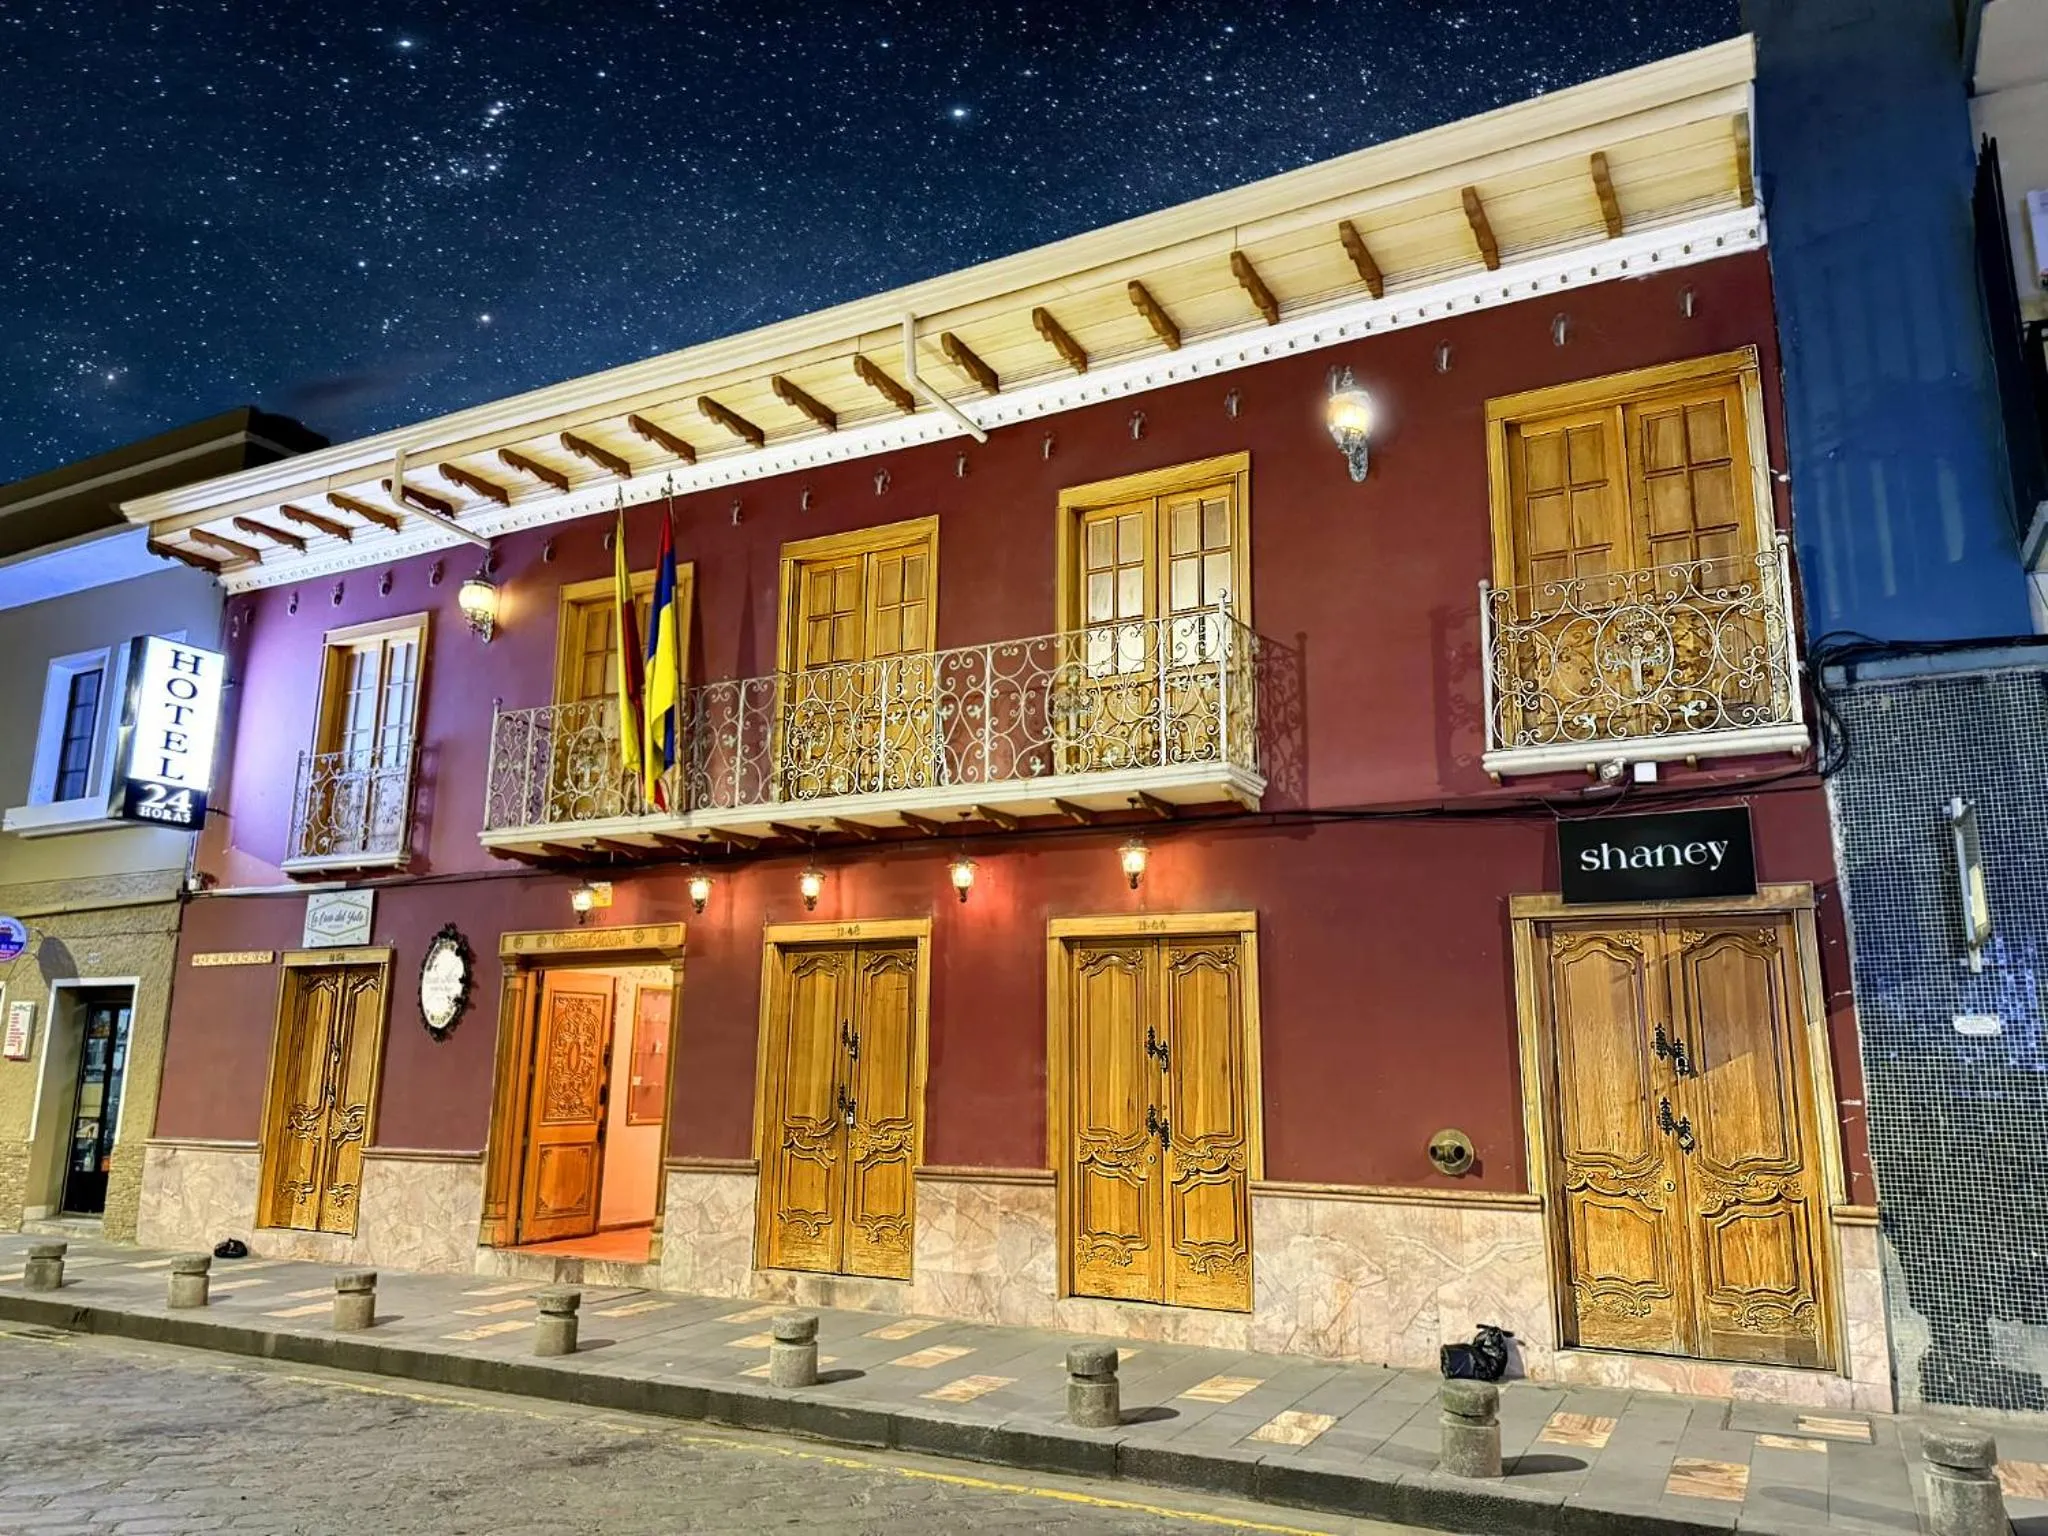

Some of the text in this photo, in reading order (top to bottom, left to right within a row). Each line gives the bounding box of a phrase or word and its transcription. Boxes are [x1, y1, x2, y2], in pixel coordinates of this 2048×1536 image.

[156, 648, 205, 781] HOTEL
[139, 784, 192, 813] 24
[138, 805, 193, 824] HORAS
[1579, 839, 1729, 872] shaney
